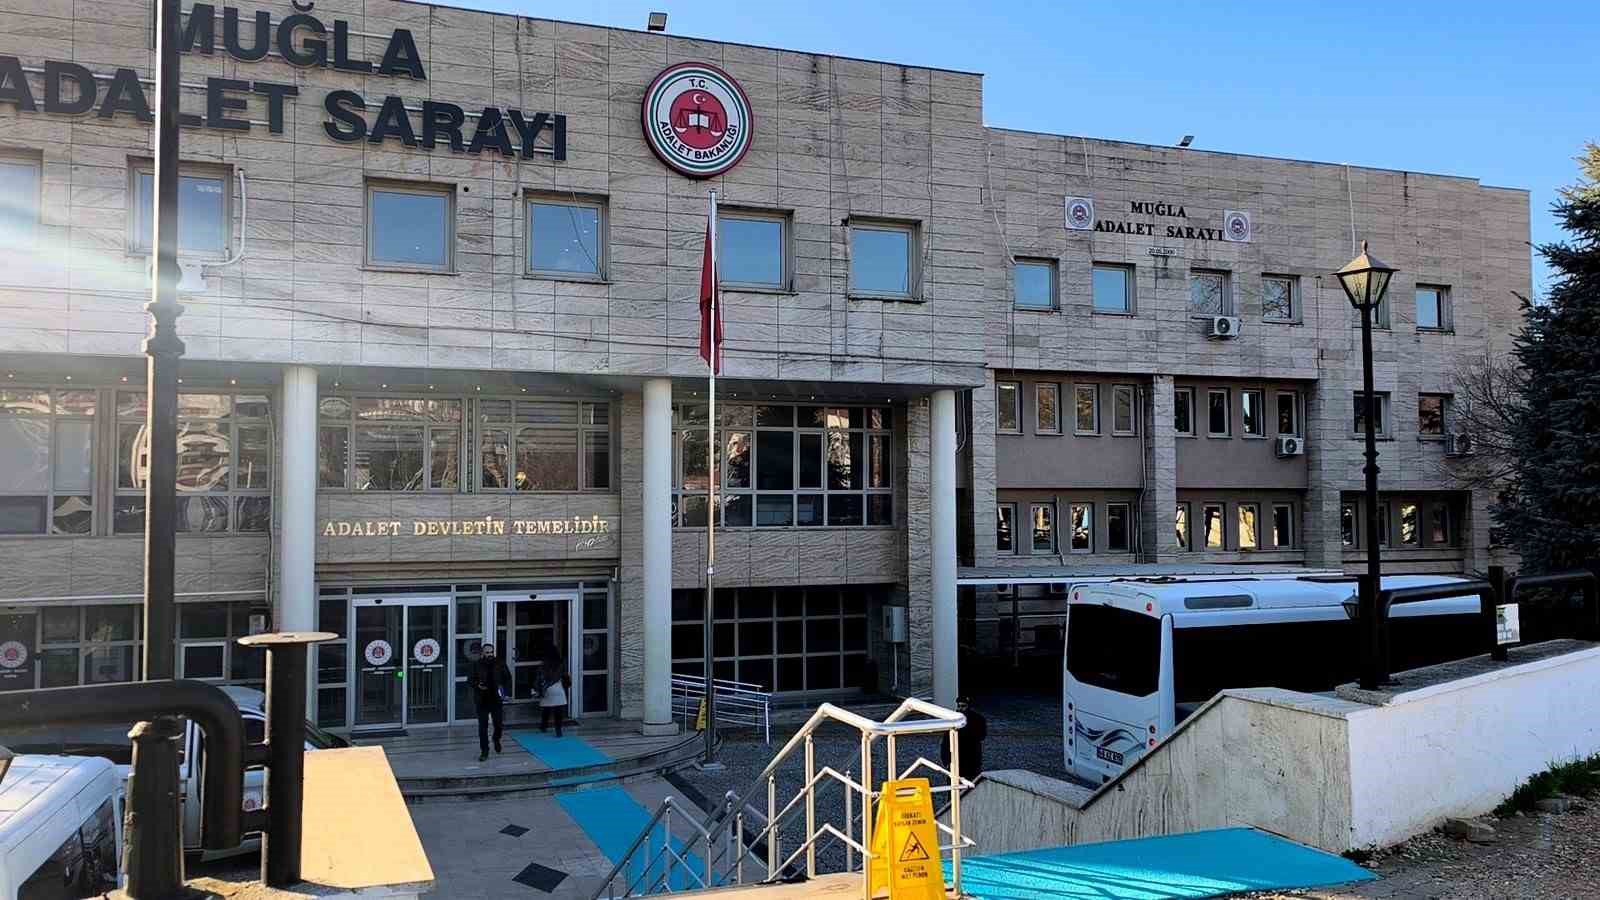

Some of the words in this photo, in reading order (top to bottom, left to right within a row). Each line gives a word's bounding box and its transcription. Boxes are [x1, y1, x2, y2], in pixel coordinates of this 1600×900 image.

[688, 78, 709, 90] T.C.
[323, 89, 566, 161] SARAYI
[660, 120, 694, 156] ADALET
[694, 124, 738, 160] BAKANLIĞI
[1131, 201, 1187, 218] MUĞLA
[1095, 220, 1155, 235] ADALET
[1166, 225, 1223, 241] SARAYI
[322, 520, 401, 537] ADALET
[413, 515, 505, 536] DEVLETİN
[513, 514, 609, 535] TEMELİDİR
